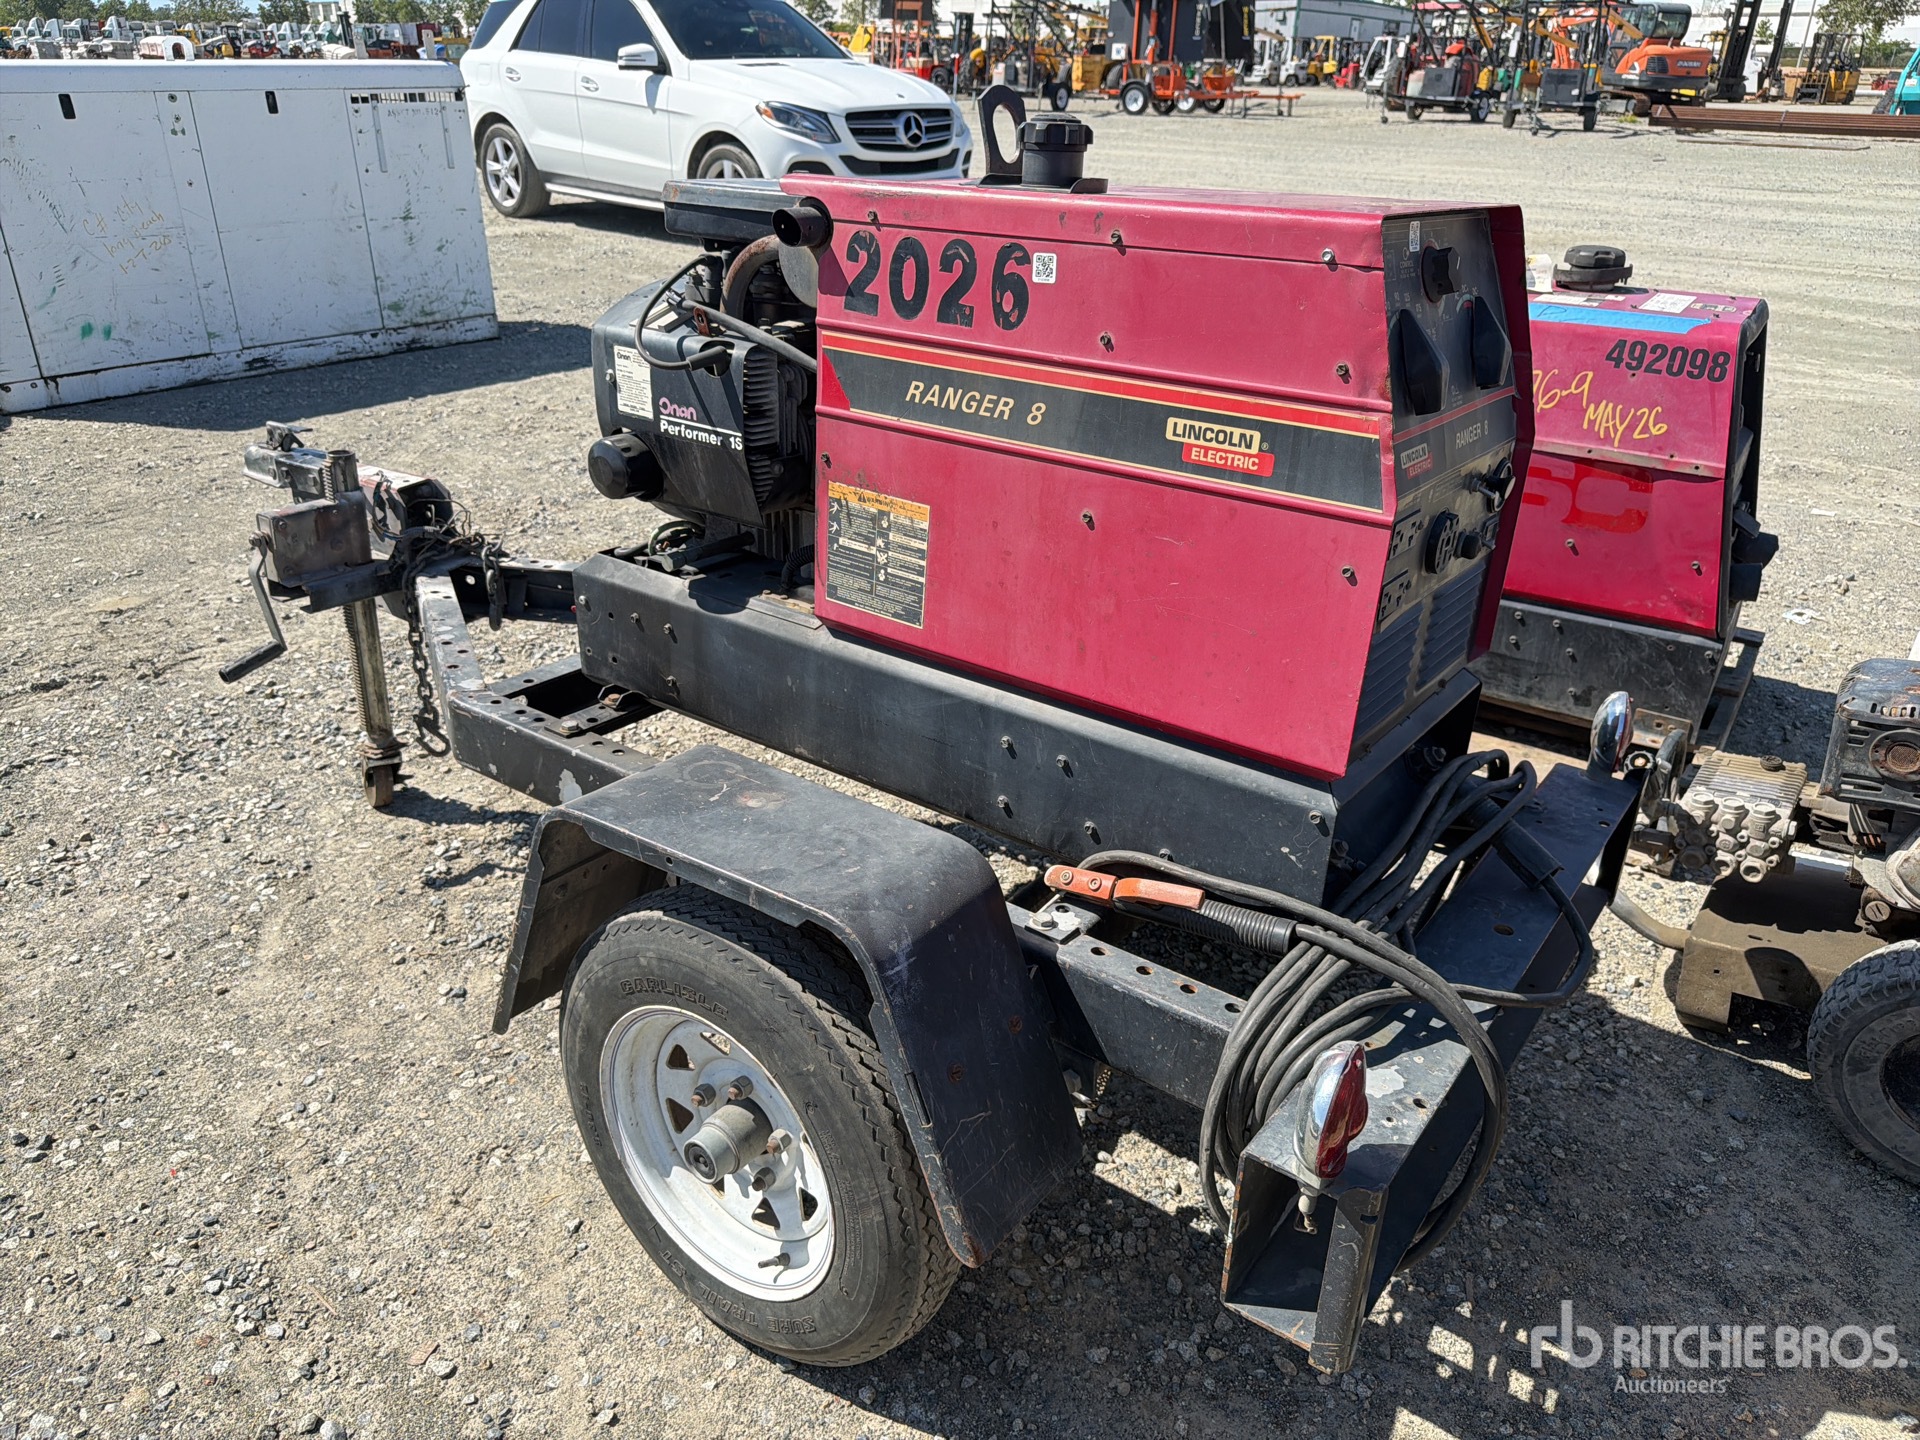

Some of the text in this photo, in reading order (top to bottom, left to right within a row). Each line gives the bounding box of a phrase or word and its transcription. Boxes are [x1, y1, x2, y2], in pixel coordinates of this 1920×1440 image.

[843, 229, 1031, 331] 2026
[1605, 338, 1731, 382] 492098
[658, 396, 697, 421] Onan
[905, 380, 1046, 425] RANGER 8
[659, 420, 723, 446] Performer
[1171, 421, 1254, 450] LINCOLN
[1455, 420, 1489, 450] RANGER 8
[1582, 399, 1668, 448] MAY 26
[1190, 447, 1260, 471] ELECTRIC
[1401, 445, 1427, 466] LINCOLN
[1409, 460, 1432, 476] ELECTRIC
[620, 976, 729, 1021] CARLISLE
[697, 1281, 759, 1327] TRAIL
[767, 1315, 818, 1335] SURE
